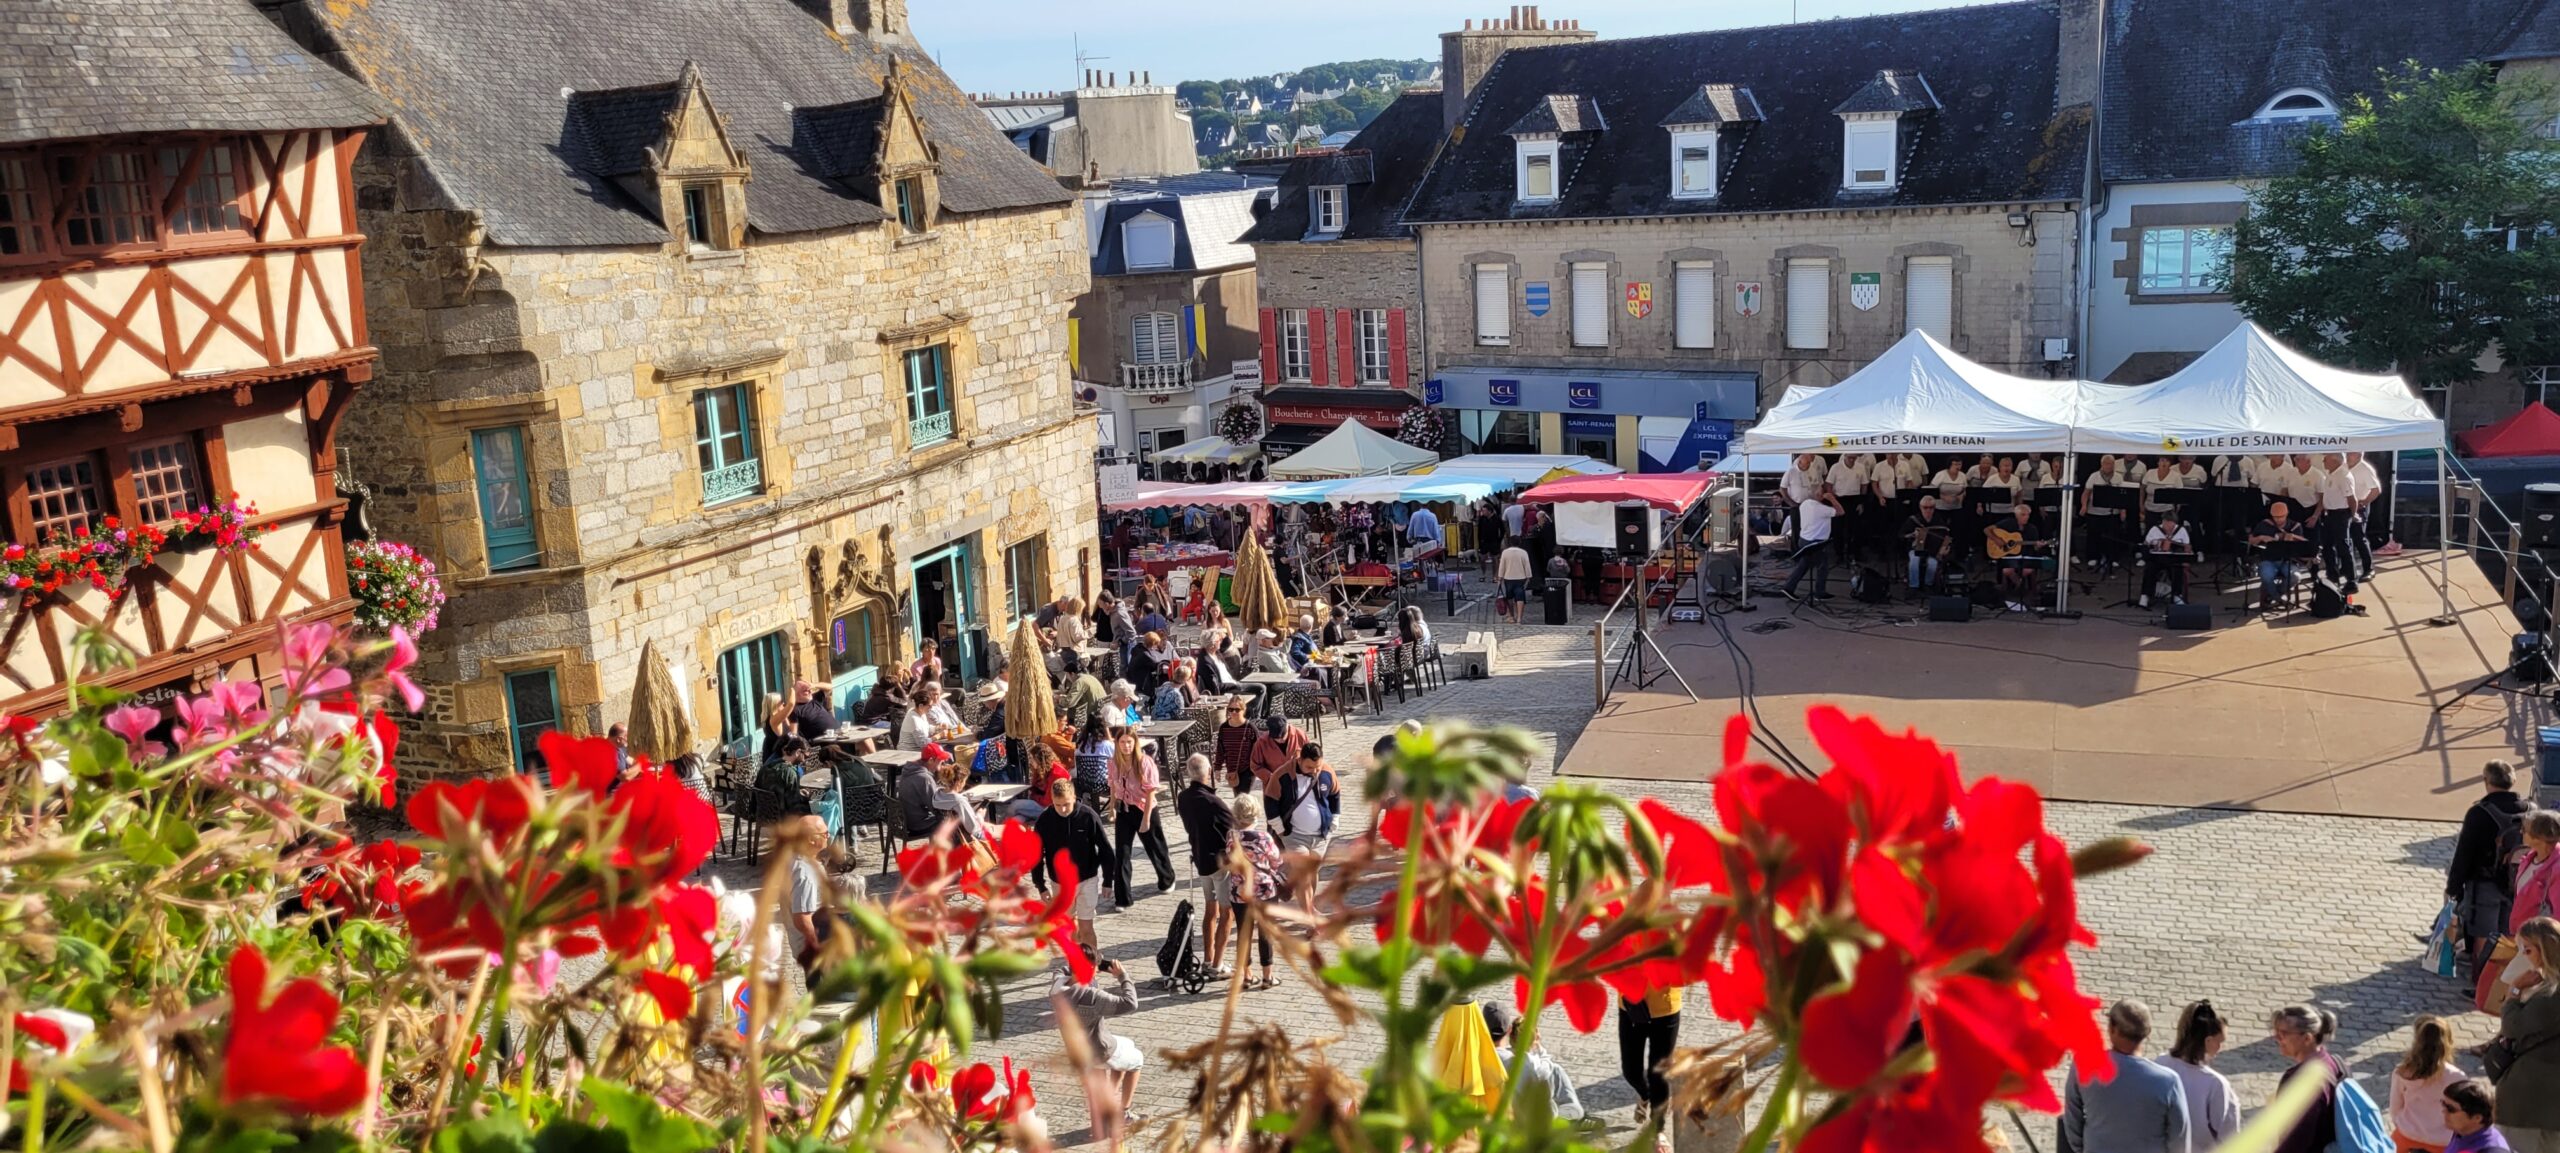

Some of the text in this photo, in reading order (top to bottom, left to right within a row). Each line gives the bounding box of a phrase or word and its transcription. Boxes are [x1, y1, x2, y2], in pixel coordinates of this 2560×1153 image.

[1491, 385, 1514, 395] LCL
[1571, 388, 1595, 398] LCL
[1274, 407, 1313, 419] Boucherie
[1567, 420, 1615, 428] SAINT-RENAN
[1842, 434, 1986, 446] VILLE DE SAINT RENAN
[2184, 434, 2349, 447] VILLE DE SAINT RENAN
